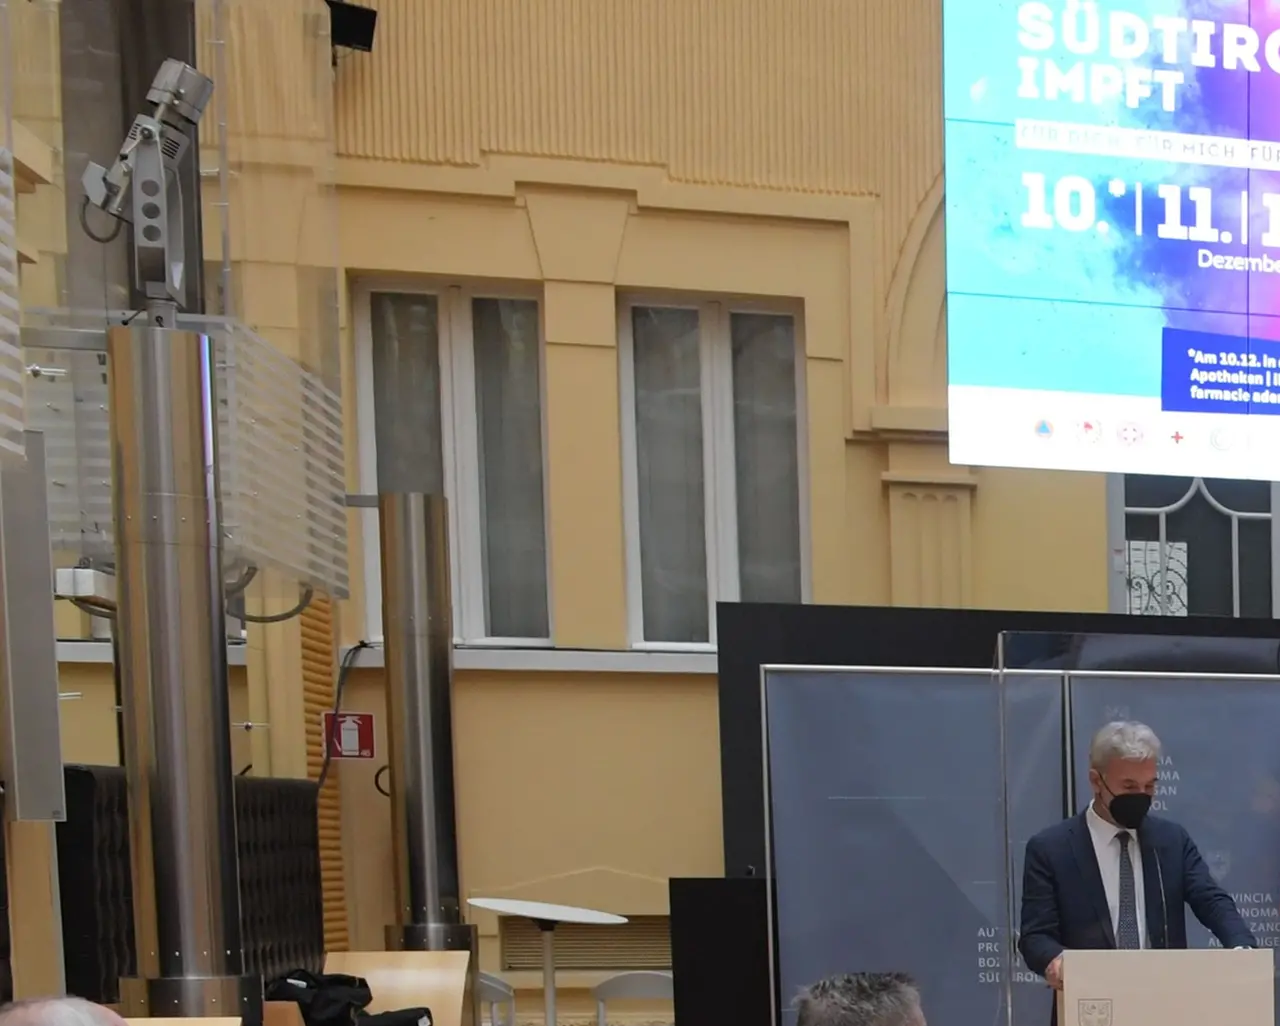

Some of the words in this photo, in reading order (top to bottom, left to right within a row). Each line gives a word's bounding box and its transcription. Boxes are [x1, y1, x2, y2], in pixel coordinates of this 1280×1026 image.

[1017, 57, 1184, 112] IMPFT
[1183, 141, 1235, 159] MICH
[1158, 184, 1232, 243] 11.
[1219, 352, 1260, 368] 10.12.
[1263, 355, 1276, 368] in
[1190, 368, 1263, 386] Apotheken
[1191, 387, 1250, 402] farmacie
